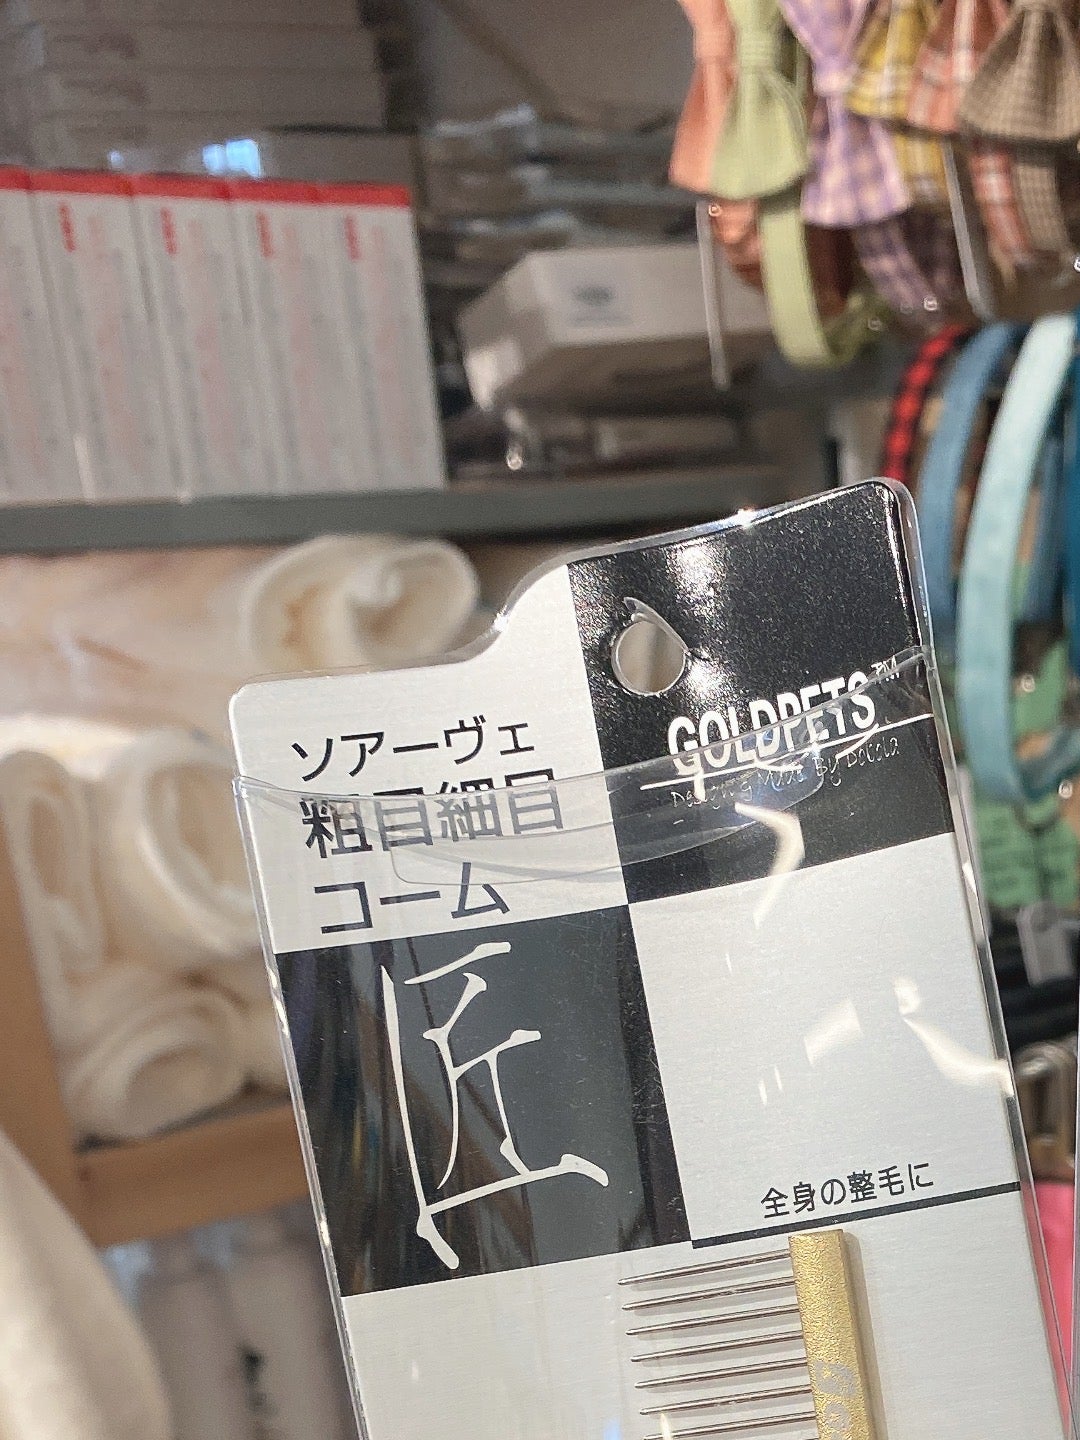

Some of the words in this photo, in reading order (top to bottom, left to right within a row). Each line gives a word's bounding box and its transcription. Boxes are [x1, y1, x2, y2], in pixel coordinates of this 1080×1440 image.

[291, 714, 535, 782] ソアーヴェ
[299, 767, 564, 859] 粗目細目
[314, 861, 510, 934] コーム
[381, 941, 609, 1270] 匠
[760, 1162, 935, 1219] 全身の整毛に
